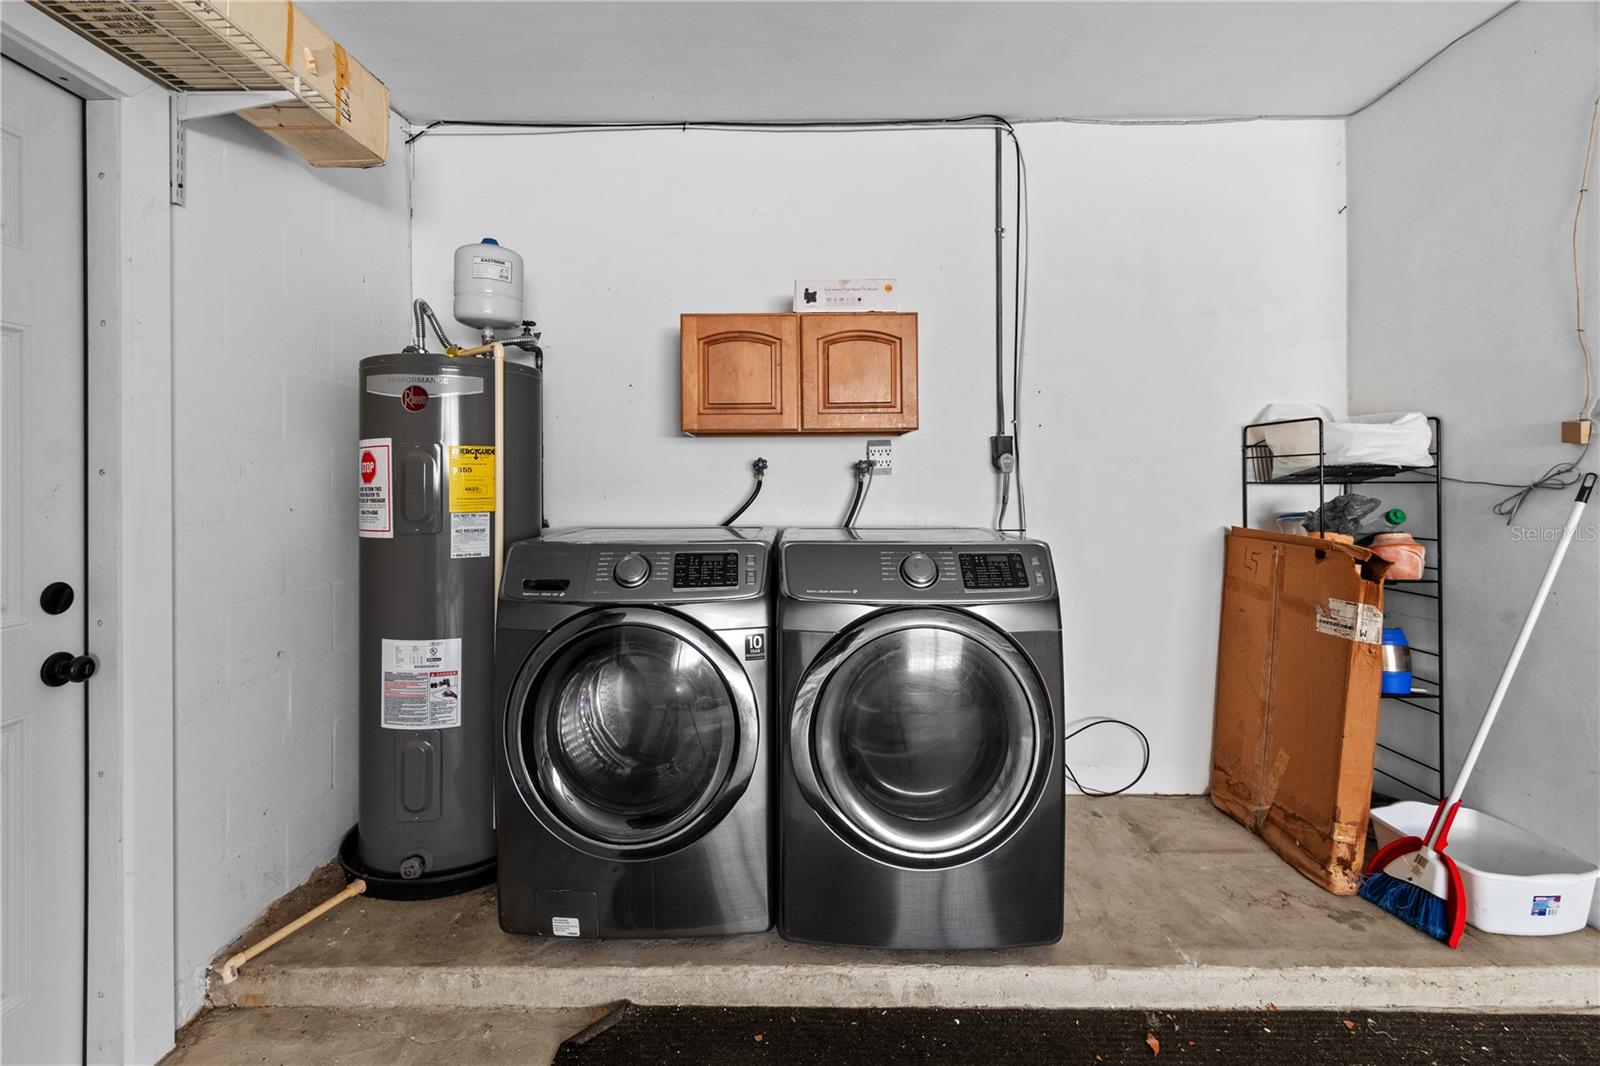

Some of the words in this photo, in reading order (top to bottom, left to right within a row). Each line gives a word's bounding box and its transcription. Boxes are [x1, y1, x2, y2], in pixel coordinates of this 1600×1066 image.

[387, 376, 449, 385] PERFORMANCE
[361, 462, 374, 473] STOP
[747, 635, 762, 649] 10
